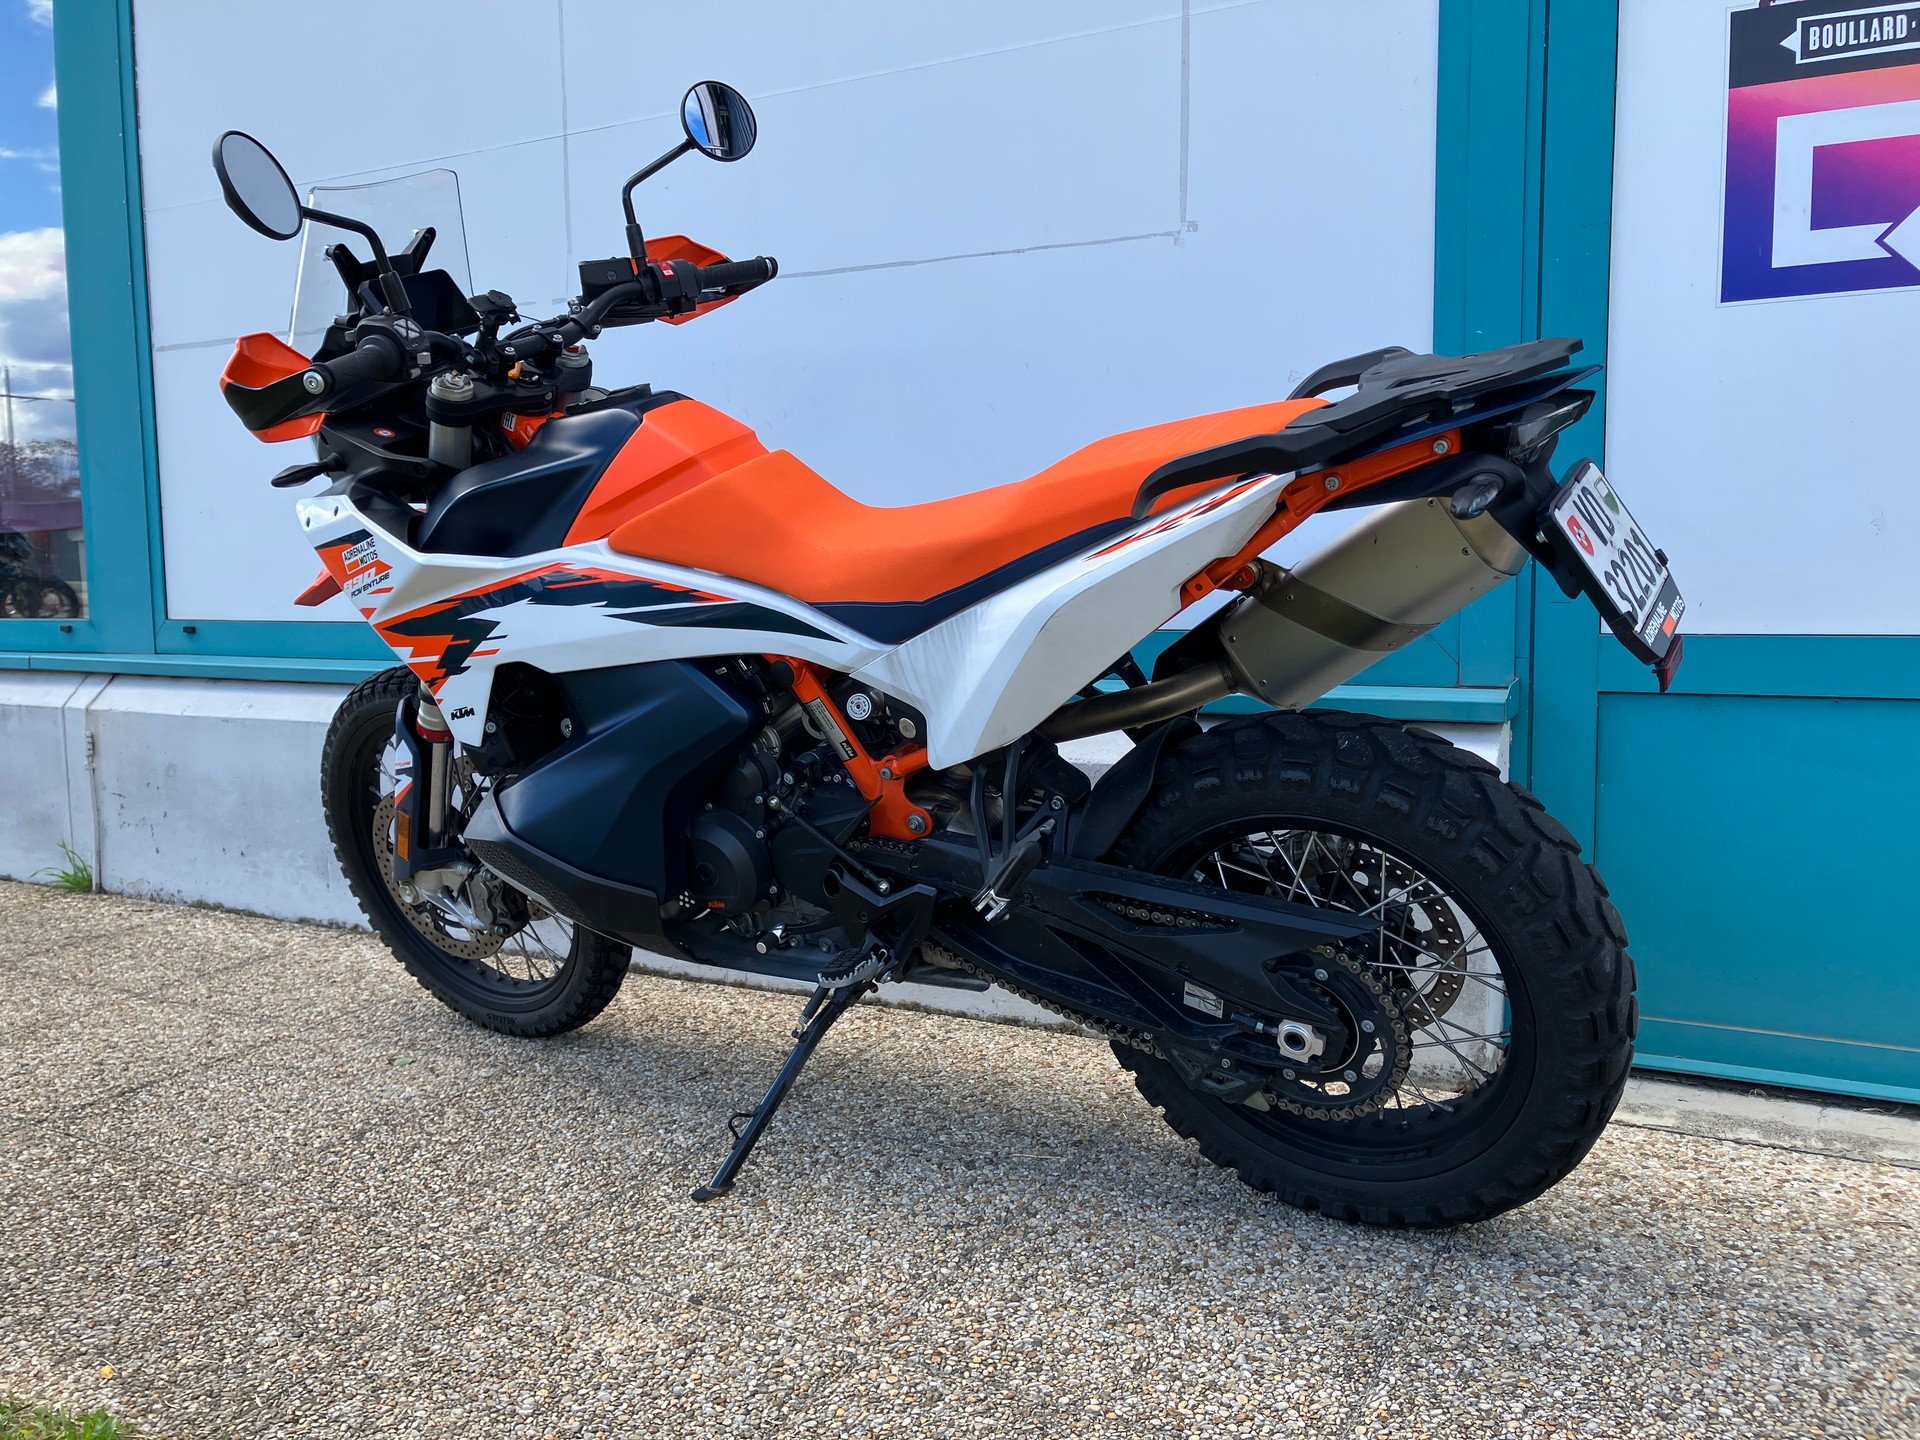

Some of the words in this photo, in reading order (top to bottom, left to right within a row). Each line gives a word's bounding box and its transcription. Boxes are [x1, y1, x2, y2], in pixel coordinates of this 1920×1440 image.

[1572, 485, 1615, 546] VD
[343, 538, 376, 562] ADRENALINE
[359, 549, 378, 566] MOTOS
[351, 572, 390, 598] ADVENTURE
[1669, 595, 1685, 623] MOTOS
[1644, 601, 1667, 646] ADRENALINE
[450, 706, 475, 721] KTM
